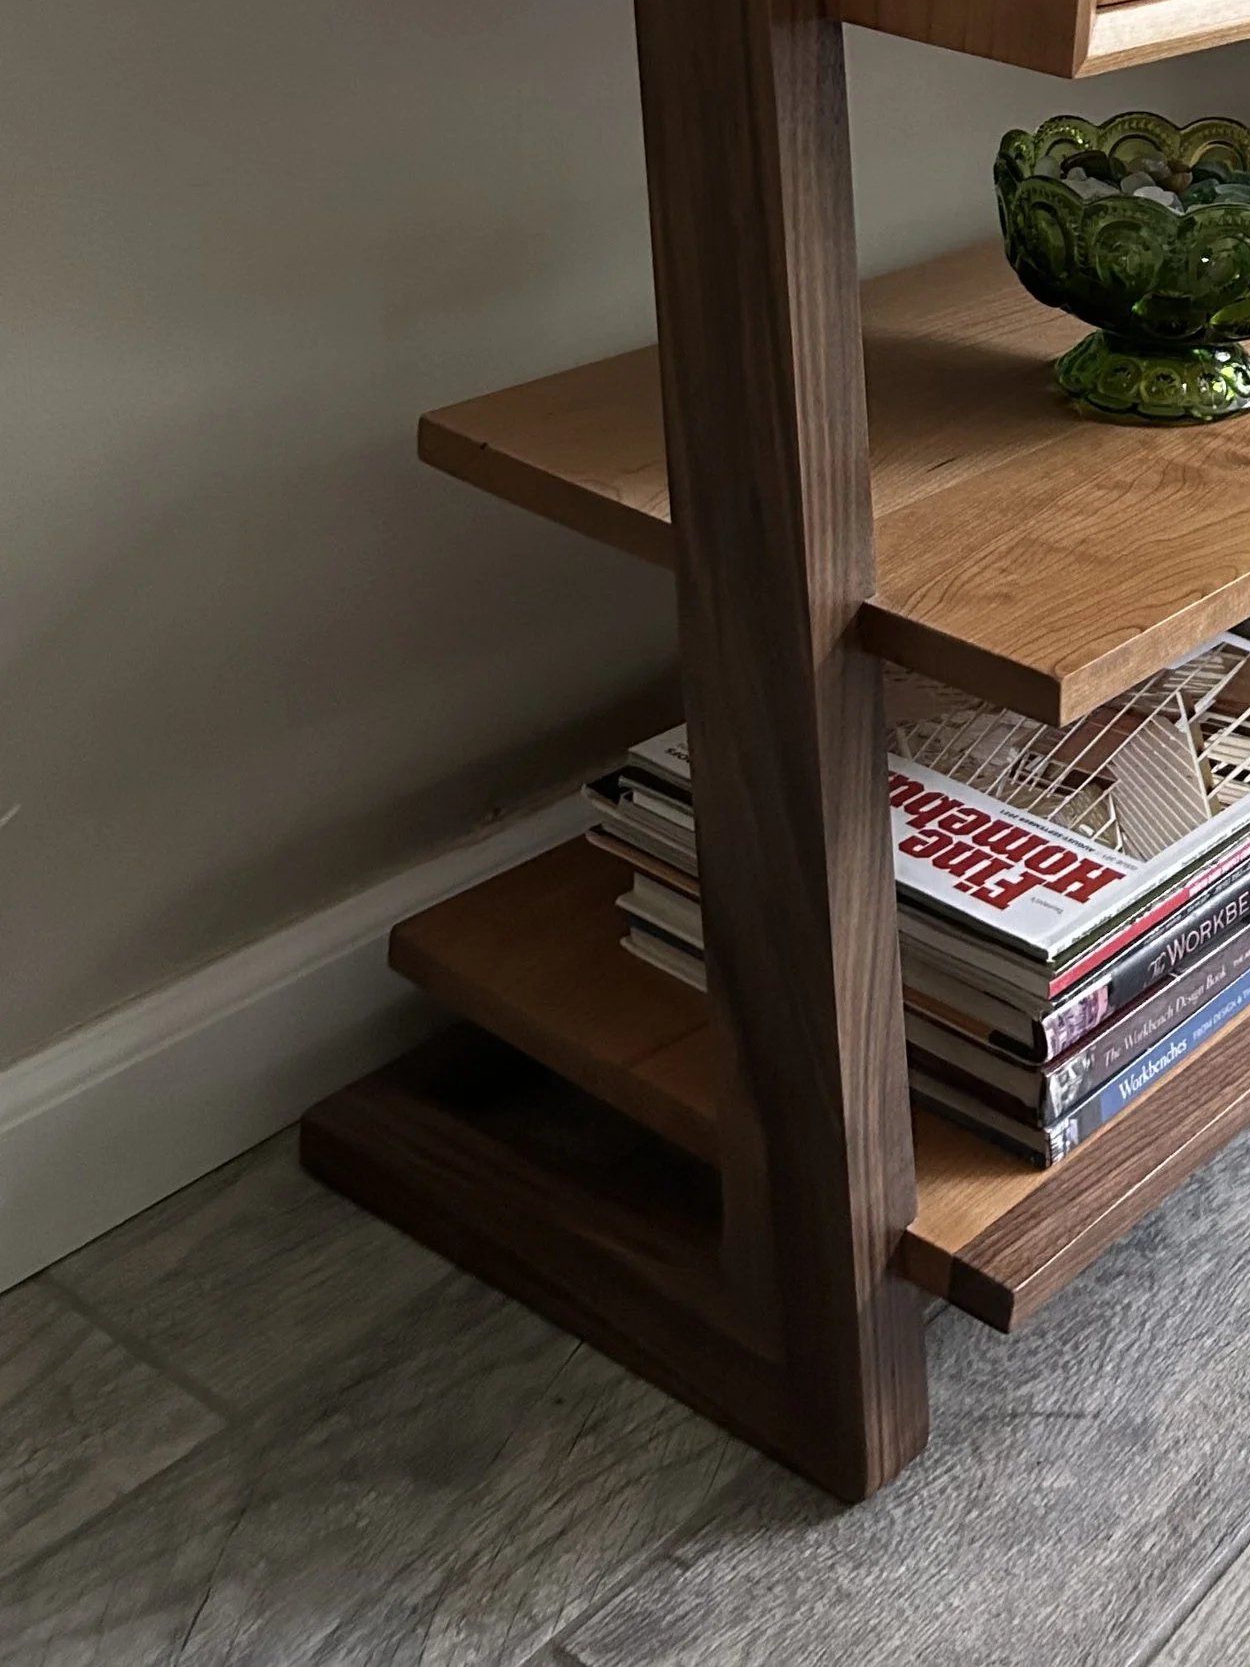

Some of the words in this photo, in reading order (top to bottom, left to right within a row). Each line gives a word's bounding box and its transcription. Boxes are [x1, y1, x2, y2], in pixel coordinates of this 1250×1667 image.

[898, 828, 1048, 911] Fine
[1104, 1047, 1120, 1067] The
[1124, 1005, 1174, 1050] Workbench
[1175, 985, 1204, 1013] Design
[1206, 964, 1226, 990] Book
[1118, 1037, 1188, 1099] Workbenches
[1193, 1019, 1212, 1040] FROM
[1213, 1001, 1237, 1025] DESIGN
